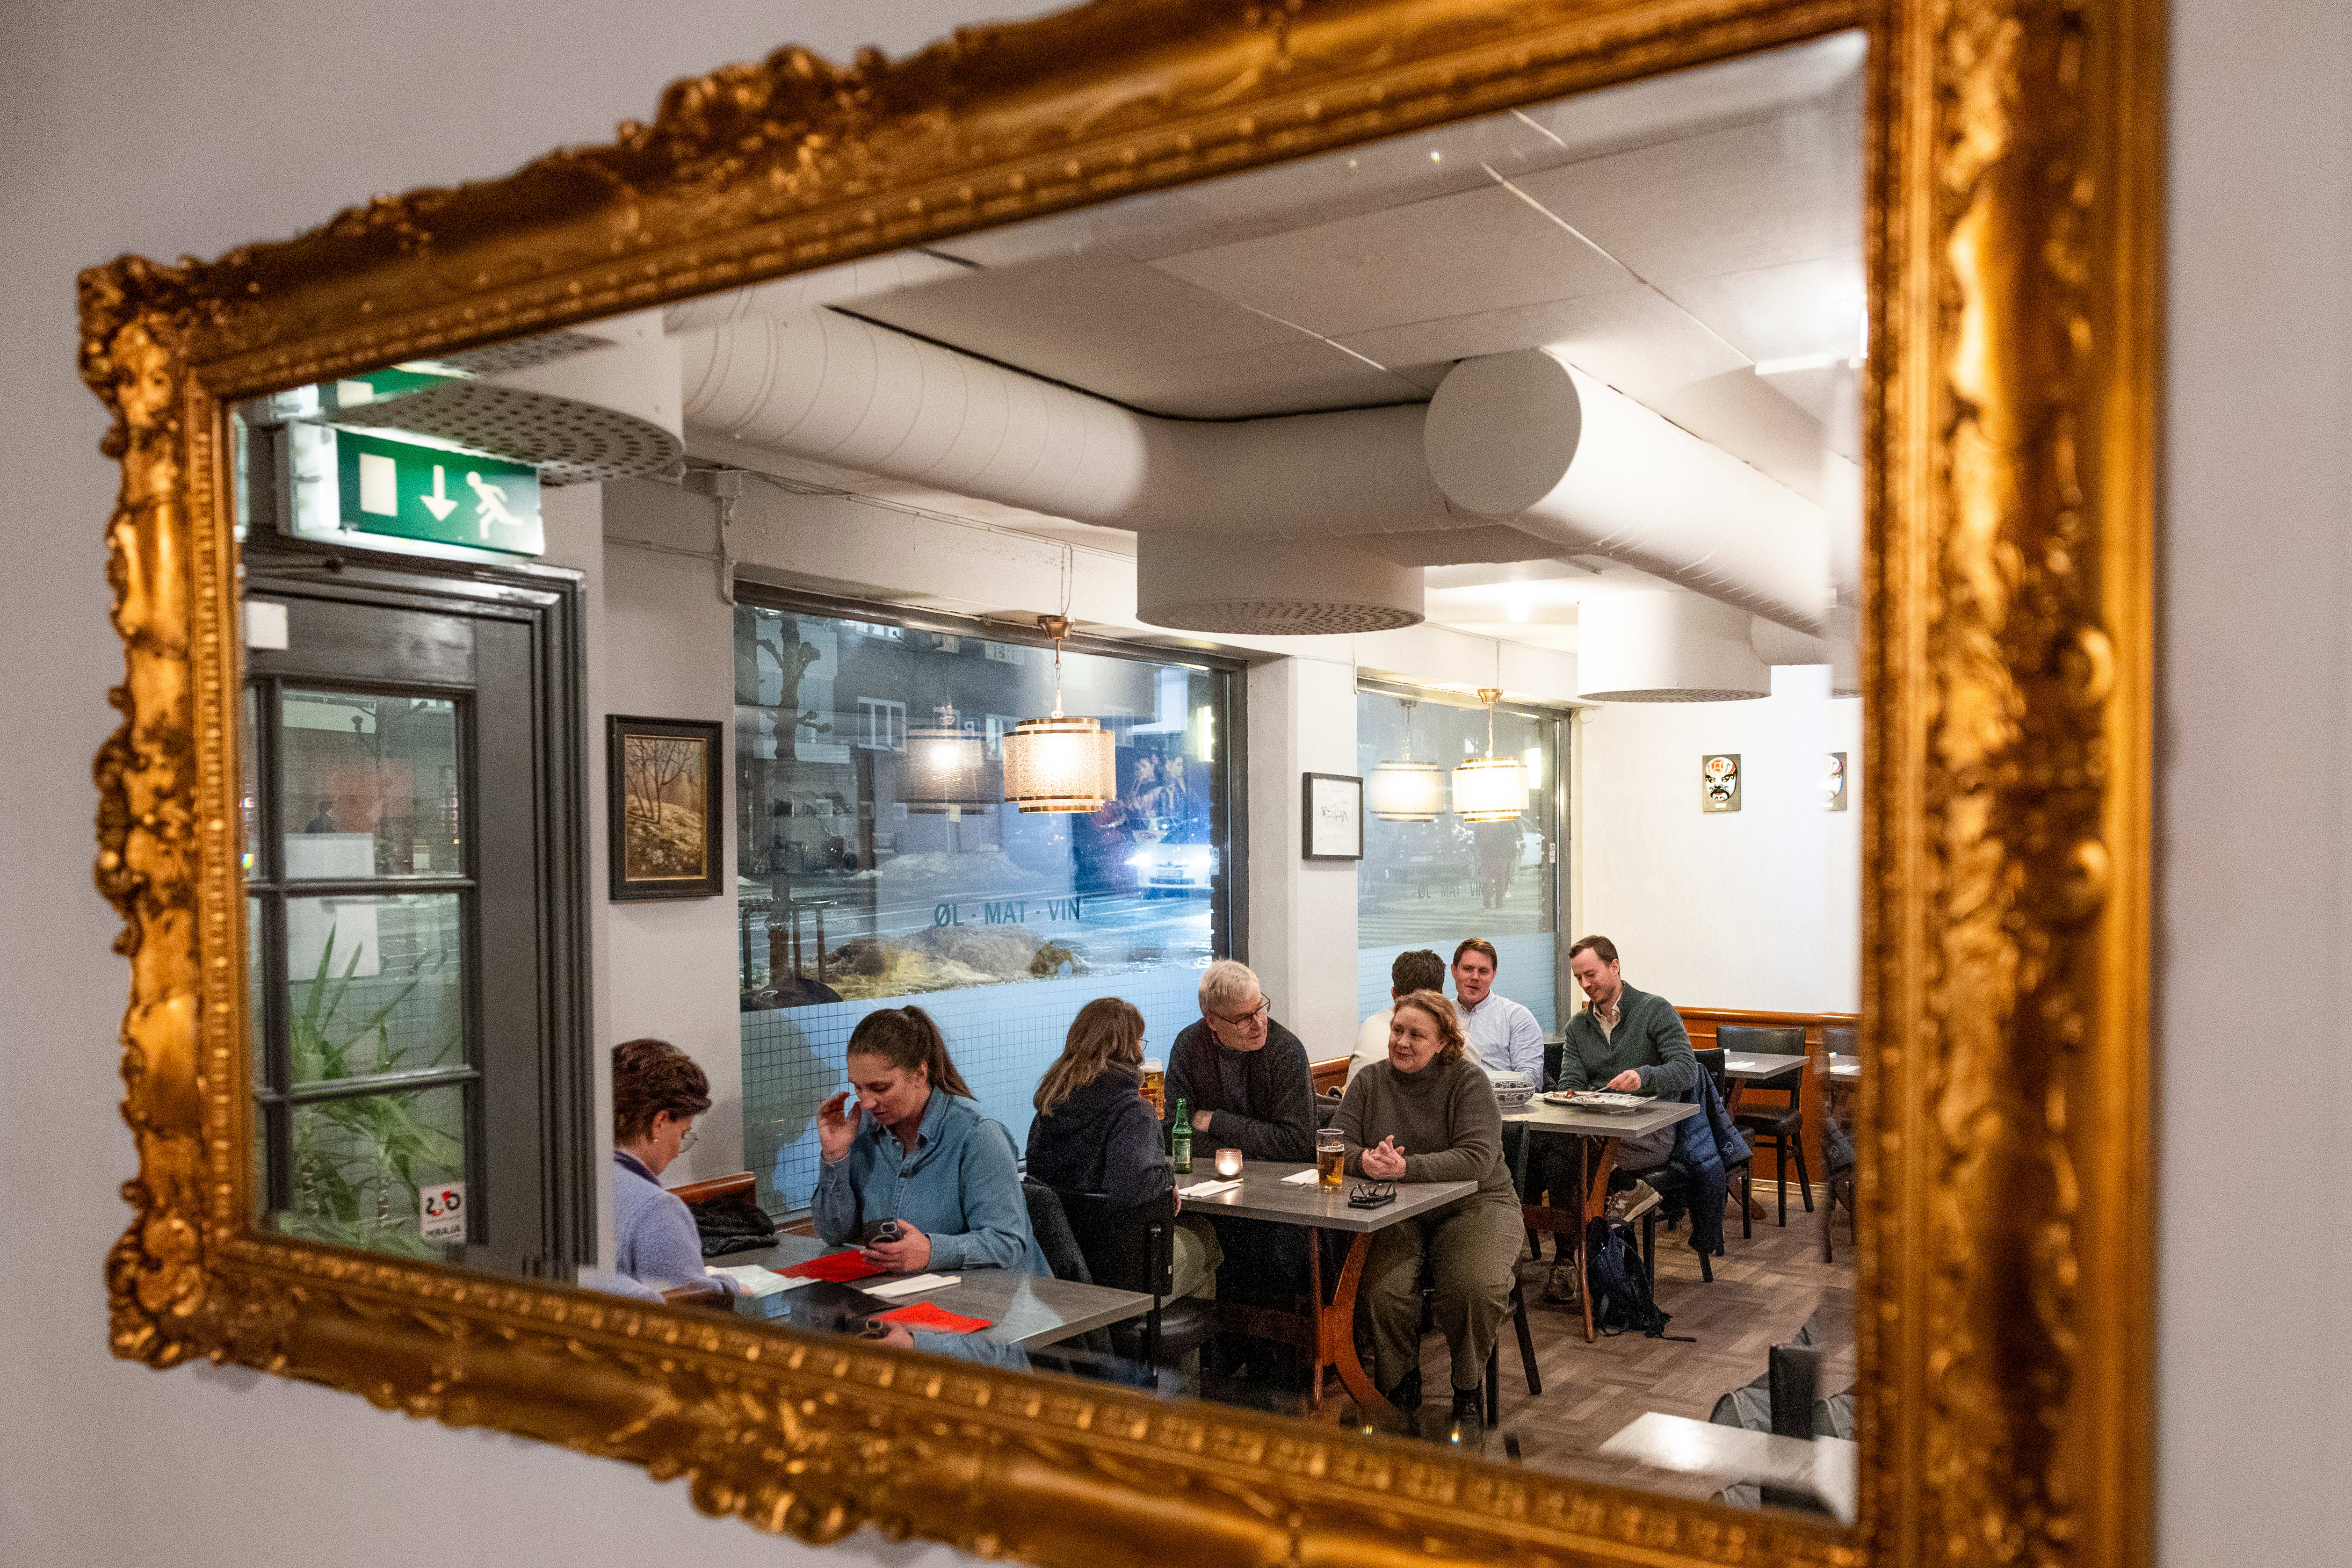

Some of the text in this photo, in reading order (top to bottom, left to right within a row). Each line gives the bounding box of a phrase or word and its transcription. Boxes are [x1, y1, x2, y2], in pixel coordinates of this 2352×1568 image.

[934, 897, 1080, 928] ØL MAT VIN
